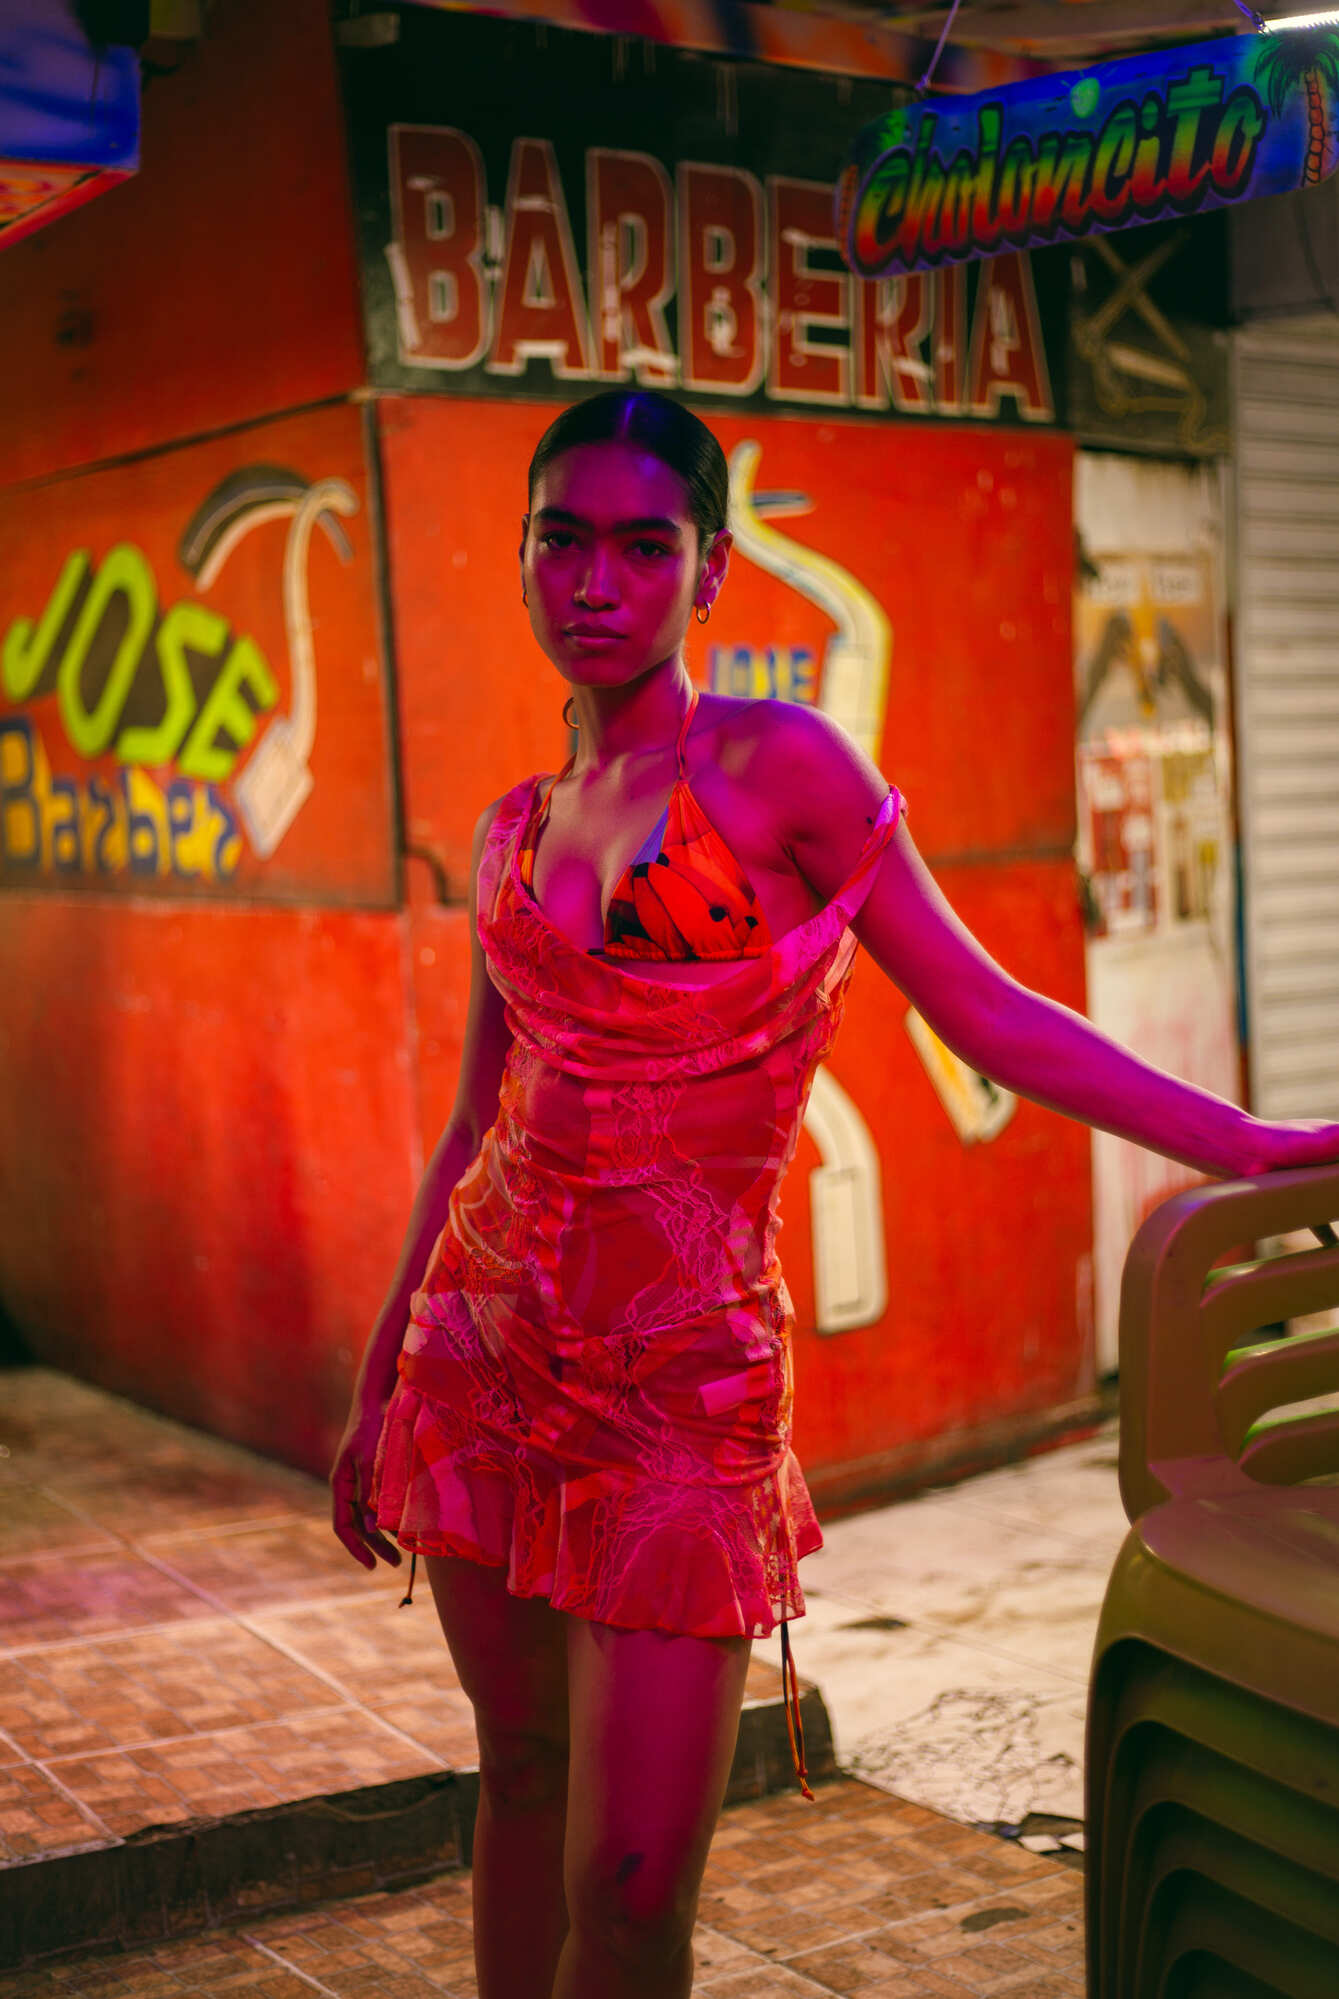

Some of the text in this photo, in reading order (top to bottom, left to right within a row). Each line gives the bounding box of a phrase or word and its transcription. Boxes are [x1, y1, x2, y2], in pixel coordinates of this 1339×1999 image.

[385, 122, 1055, 424] BARBERIA
[2, 541, 280, 783] JOSE
[0, 714, 244, 883] Barber
